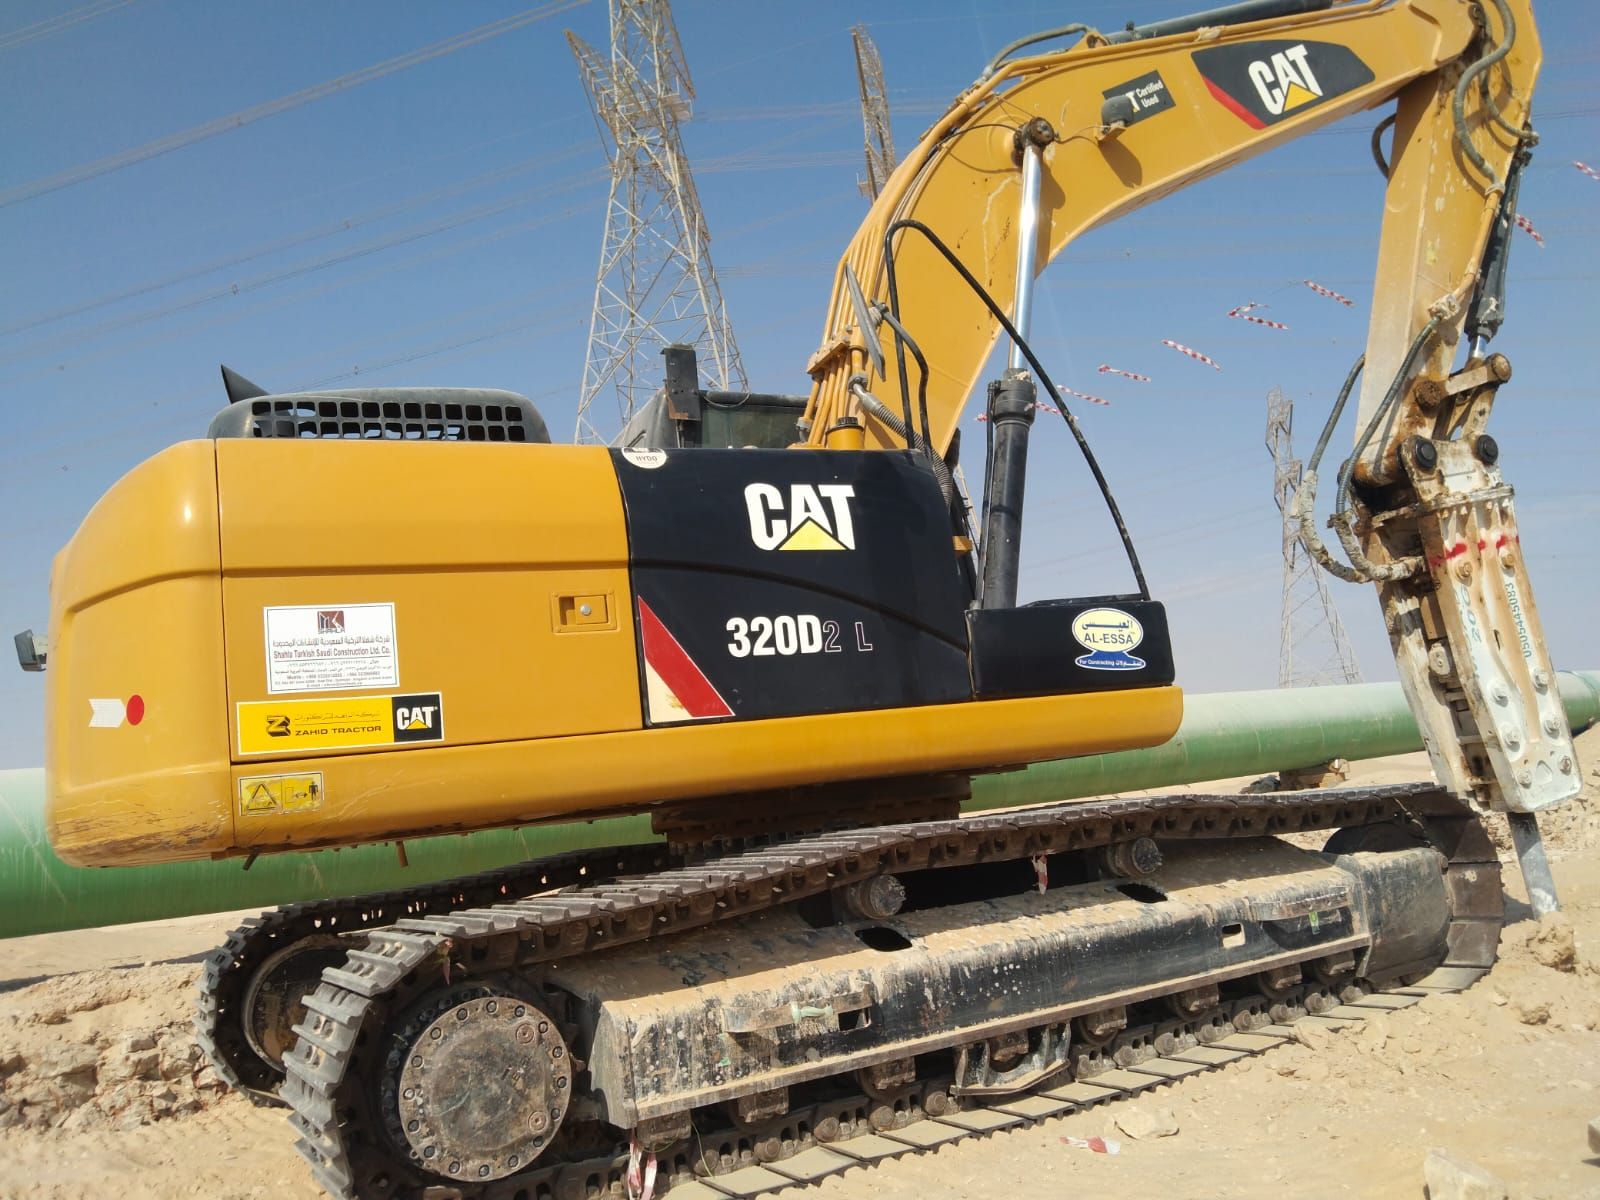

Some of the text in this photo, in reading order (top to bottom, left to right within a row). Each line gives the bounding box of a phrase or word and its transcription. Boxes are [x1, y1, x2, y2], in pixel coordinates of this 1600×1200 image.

[1248, 44, 1323, 115] CAT
[1135, 80, 1164, 98] Certified
[1140, 94, 1160, 108] Used
[744, 483, 855, 550] CAT
[855, 622, 873, 652] L
[1083, 632, 1134, 645] AL-ESSA
[333, 647, 369, 657] Construction
[396, 706, 435, 730] CAT
[295, 725, 382, 737] ZAHID TRACTOR
